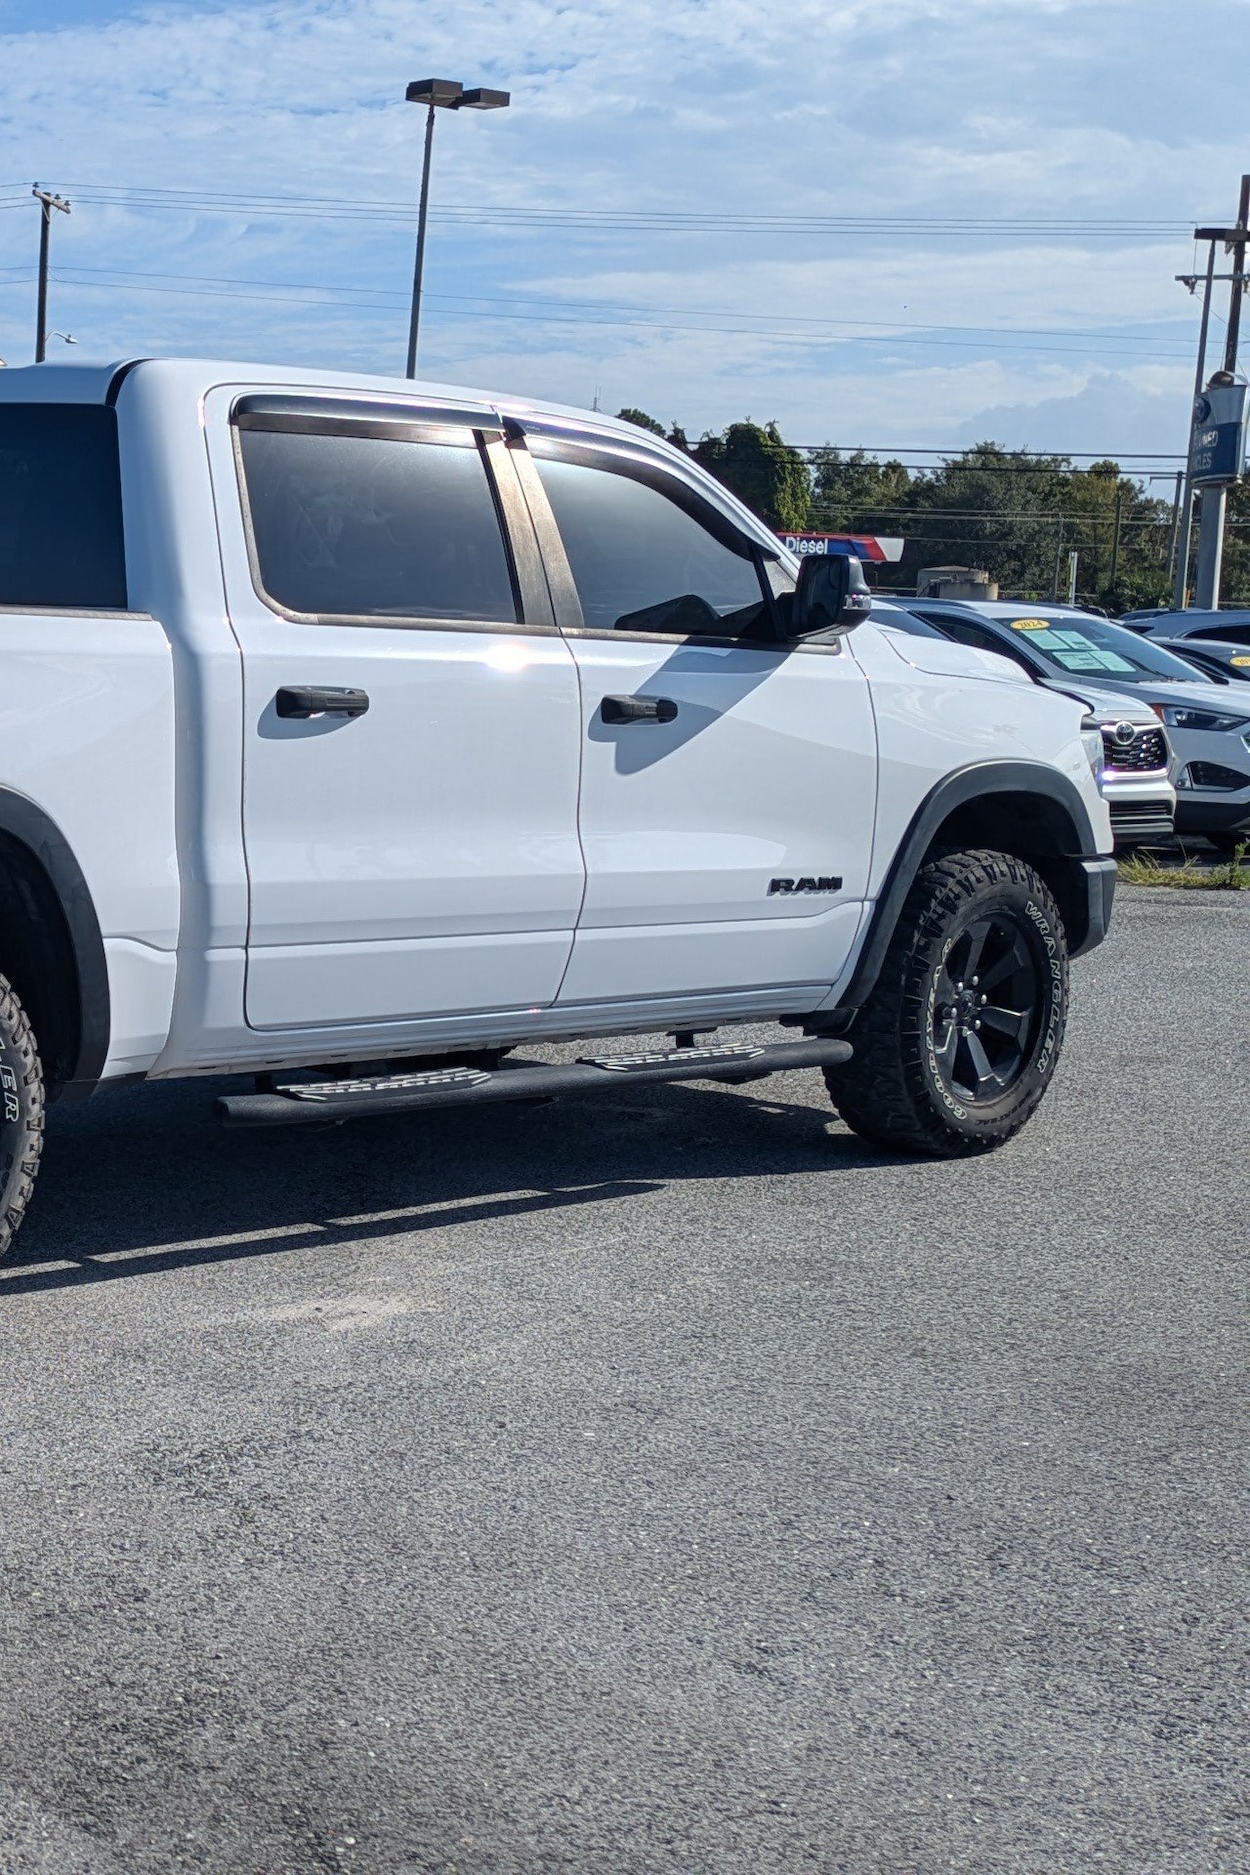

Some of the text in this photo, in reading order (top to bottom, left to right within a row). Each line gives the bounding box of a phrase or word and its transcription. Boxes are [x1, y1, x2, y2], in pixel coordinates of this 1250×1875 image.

[785, 536, 828, 555] Diesel
[1017, 619, 1044, 630] 2024
[768, 876, 843, 894] RAM
[1025, 901, 1062, 1074] WRANGLER
